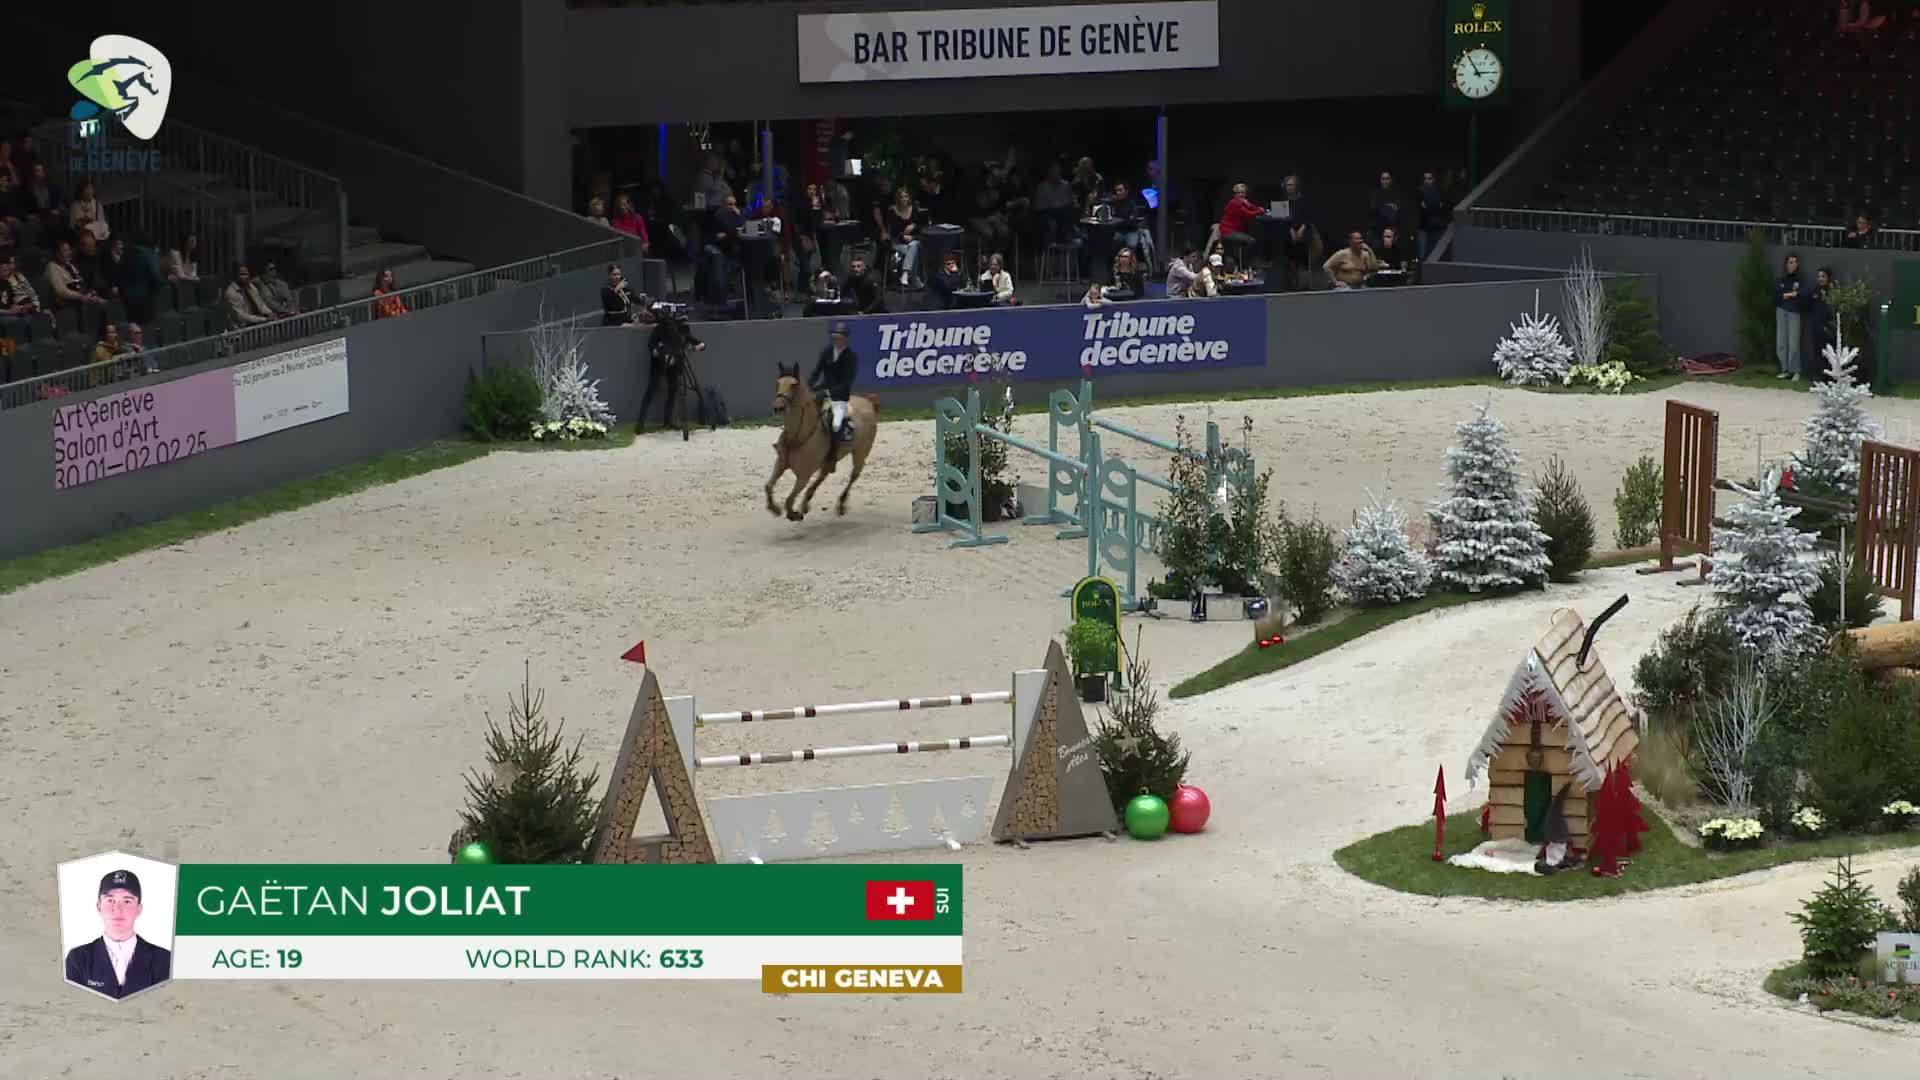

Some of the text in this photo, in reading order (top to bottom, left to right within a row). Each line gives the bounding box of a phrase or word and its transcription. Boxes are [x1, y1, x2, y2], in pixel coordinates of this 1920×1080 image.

[854, 15, 1180, 64] BAR TRIBUNE DE GENÈVE
[1455, 21, 1503, 34] ROLEX
[879, 322, 991, 350] Tribune
[1083, 311, 1195, 340] Tribune
[1080, 336, 1229, 366] deGenève
[55, 431, 107, 465] Salon
